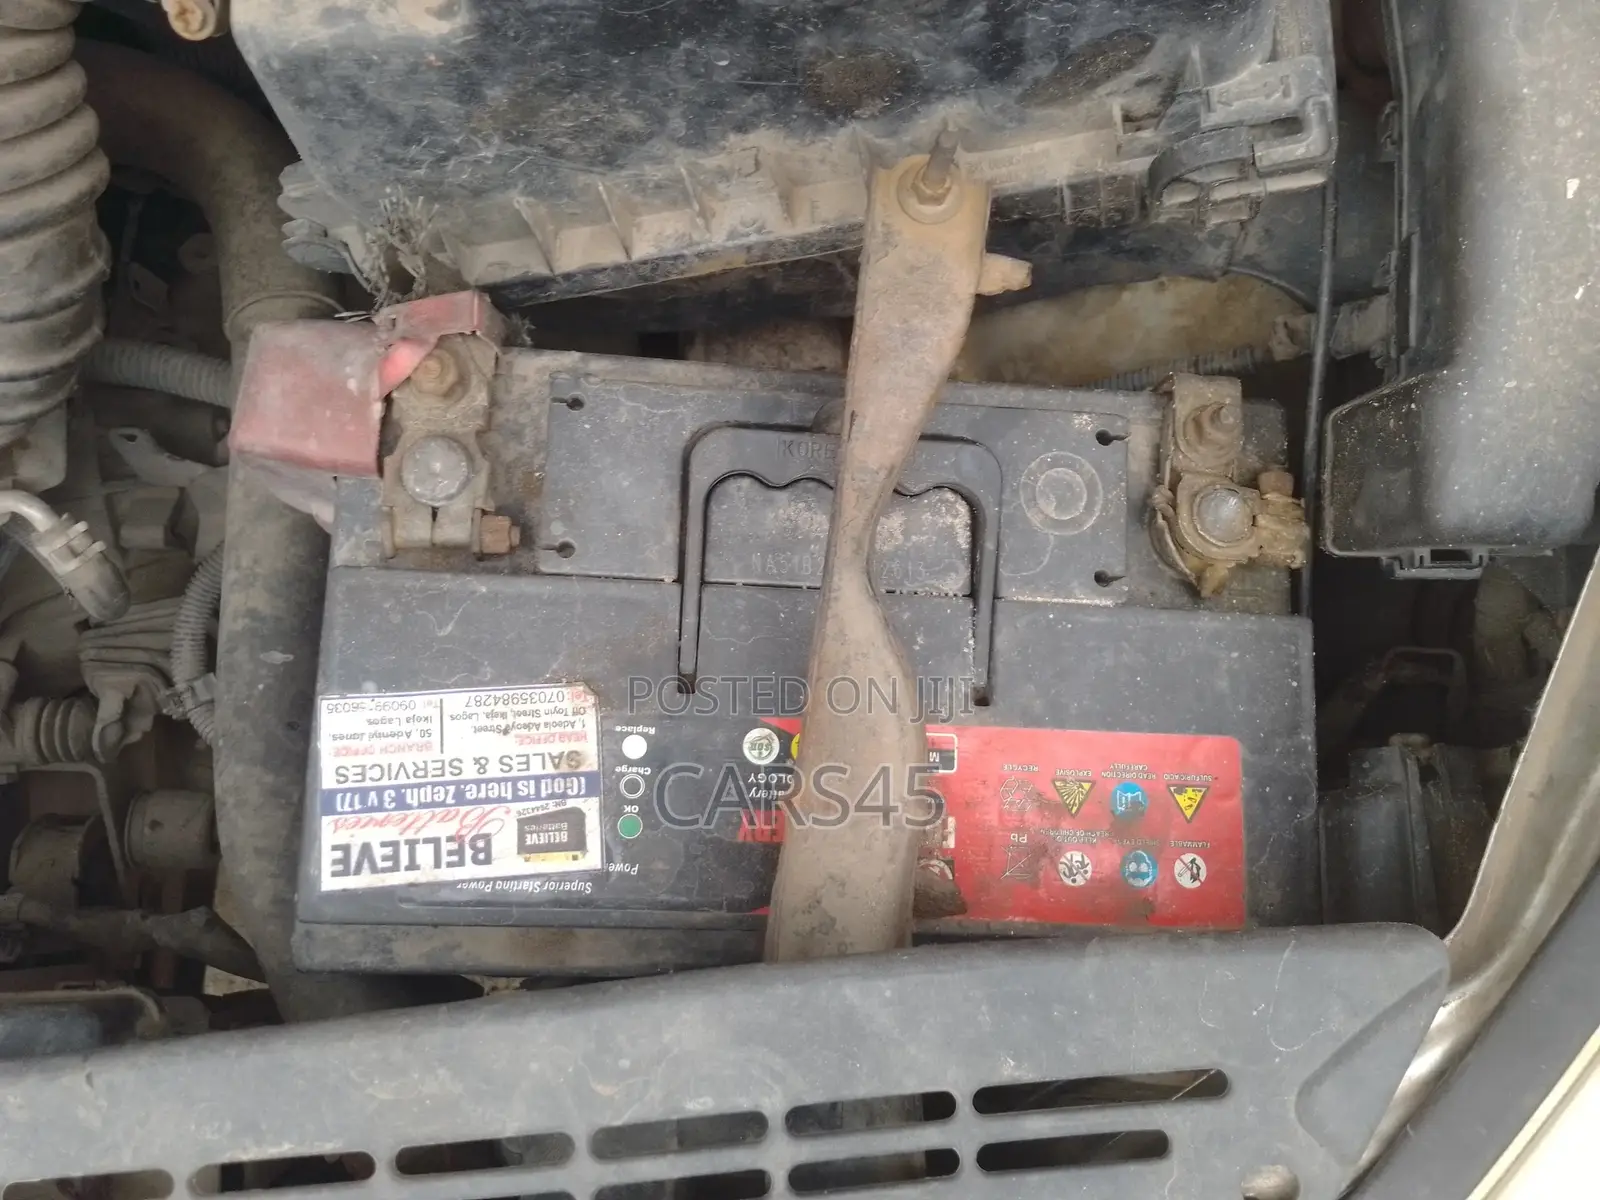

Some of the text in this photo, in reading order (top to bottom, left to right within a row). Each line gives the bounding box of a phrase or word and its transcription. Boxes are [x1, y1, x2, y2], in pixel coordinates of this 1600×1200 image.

[782, 440, 838, 459] KORE
[465, 690, 565, 707] 07035984287
[543, 706, 569, 718] Toyin
[571, 706, 587, 716] Off
[405, 713, 432, 725] Ikeja
[544, 720, 576, 731] Adeola
[615, 725, 656, 734] Replace
[379, 741, 433, 753] BRANCH
[334, 750, 582, 784] SALES & SERVICES
[615, 765, 651, 774] Charge
[1002, 764, 1039, 772] RECYCLE
[1109, 763, 1148, 771] CAREFULLY
[748, 773, 793, 784] OLOGY
[1101, 770, 1138, 778] DIRECTION
[1163, 773, 1212, 781] SULFURIC ACID
[401, 783, 455, 807] Zeph.
[460, 782, 512, 803] here.
[517, 779, 536, 800] is
[383, 790, 396, 807] 3
[624, 805, 639, 813] OK
[325, 805, 510, 844] Batteries
[524, 822, 568, 833] Batteries
[524, 830, 568, 845] BELIEVE
[1010, 832, 1027, 843] Pb
[1169, 840, 1210, 848] FLAMMABLE
[330, 833, 493, 877] BELIEVE
[456, 881, 493, 891] Power
[544, 880, 592, 893] Superior
